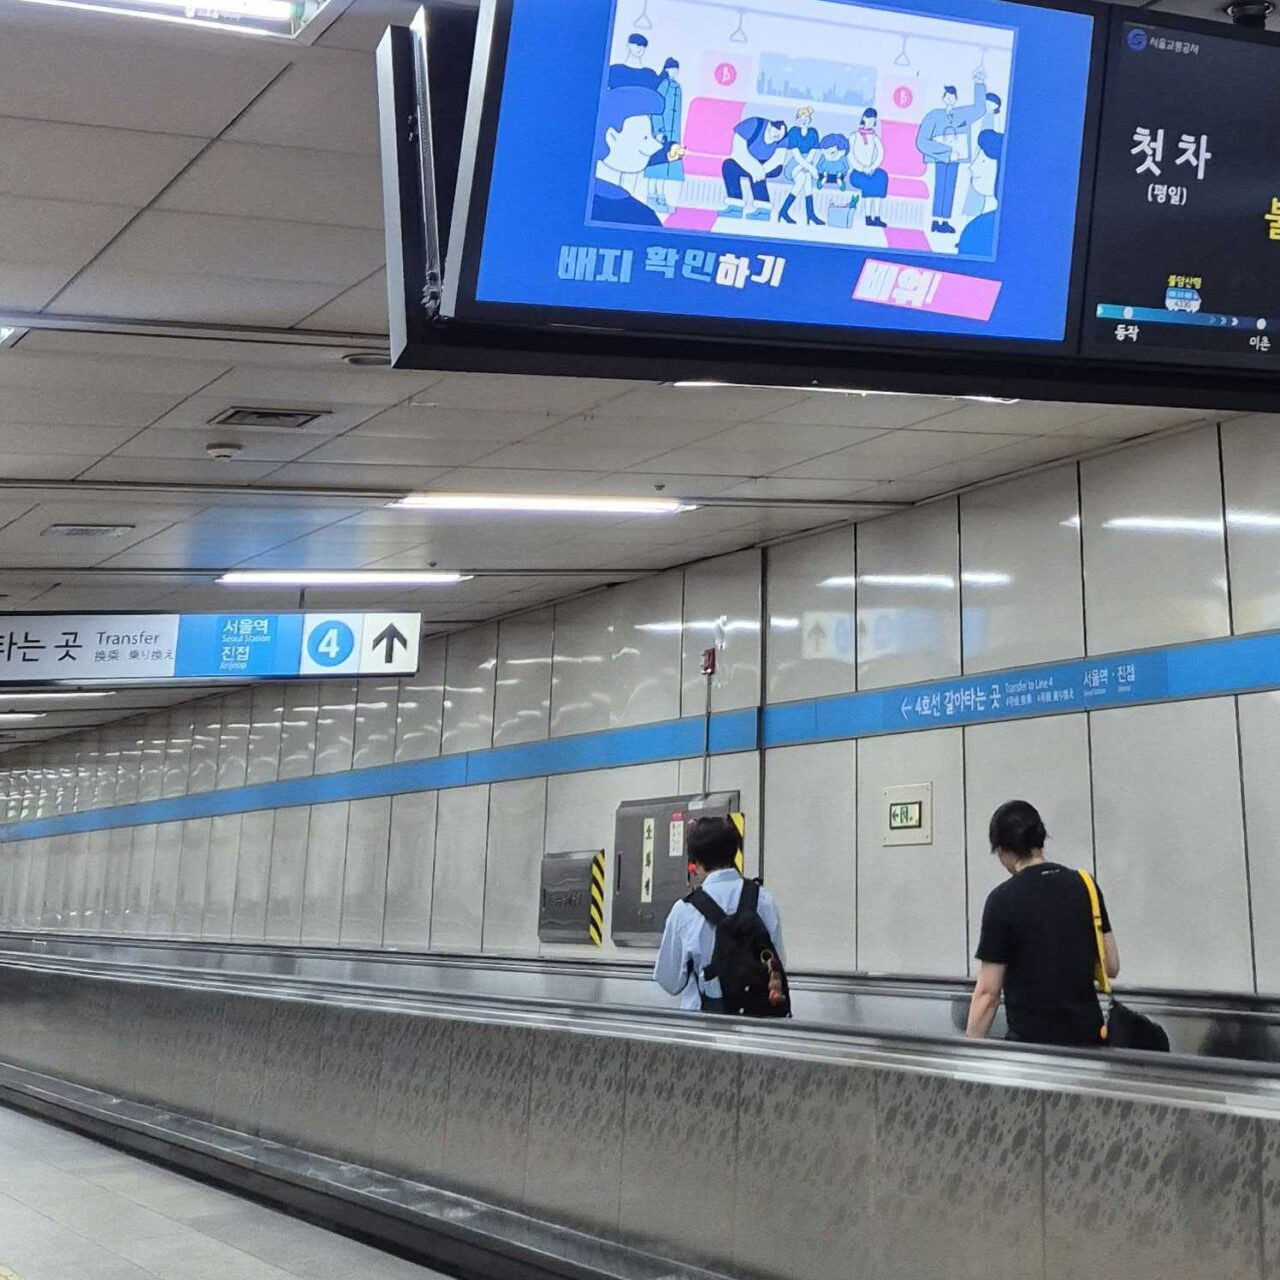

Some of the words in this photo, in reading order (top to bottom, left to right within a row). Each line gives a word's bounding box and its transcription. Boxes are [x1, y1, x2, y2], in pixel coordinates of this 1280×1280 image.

[1147, 183, 1188, 206] (평일)
[557, 244, 634, 283] 배지
[645, 246, 787, 289] 확인하기
[1114, 324, 1140, 342] 동작
[1249, 336, 1272, 352] 이촌
[223, 618, 269, 635] 서울역
[54, 631, 83, 662] 곳
[96, 630, 160, 645] Transfer
[222, 634, 243, 642] Seoul
[245, 634, 271, 642] Station
[317, 628, 340, 658] 4
[220, 644, 250, 661] 진접
[1083, 668, 1108, 687] 서울역
[1117, 664, 1135, 683] 진접
[1004, 680, 1027, 693] Transfer
[914, 695, 941, 717] 4호선
[943, 687, 985, 716] 갈아타는
[989, 684, 1002, 709] 곳
